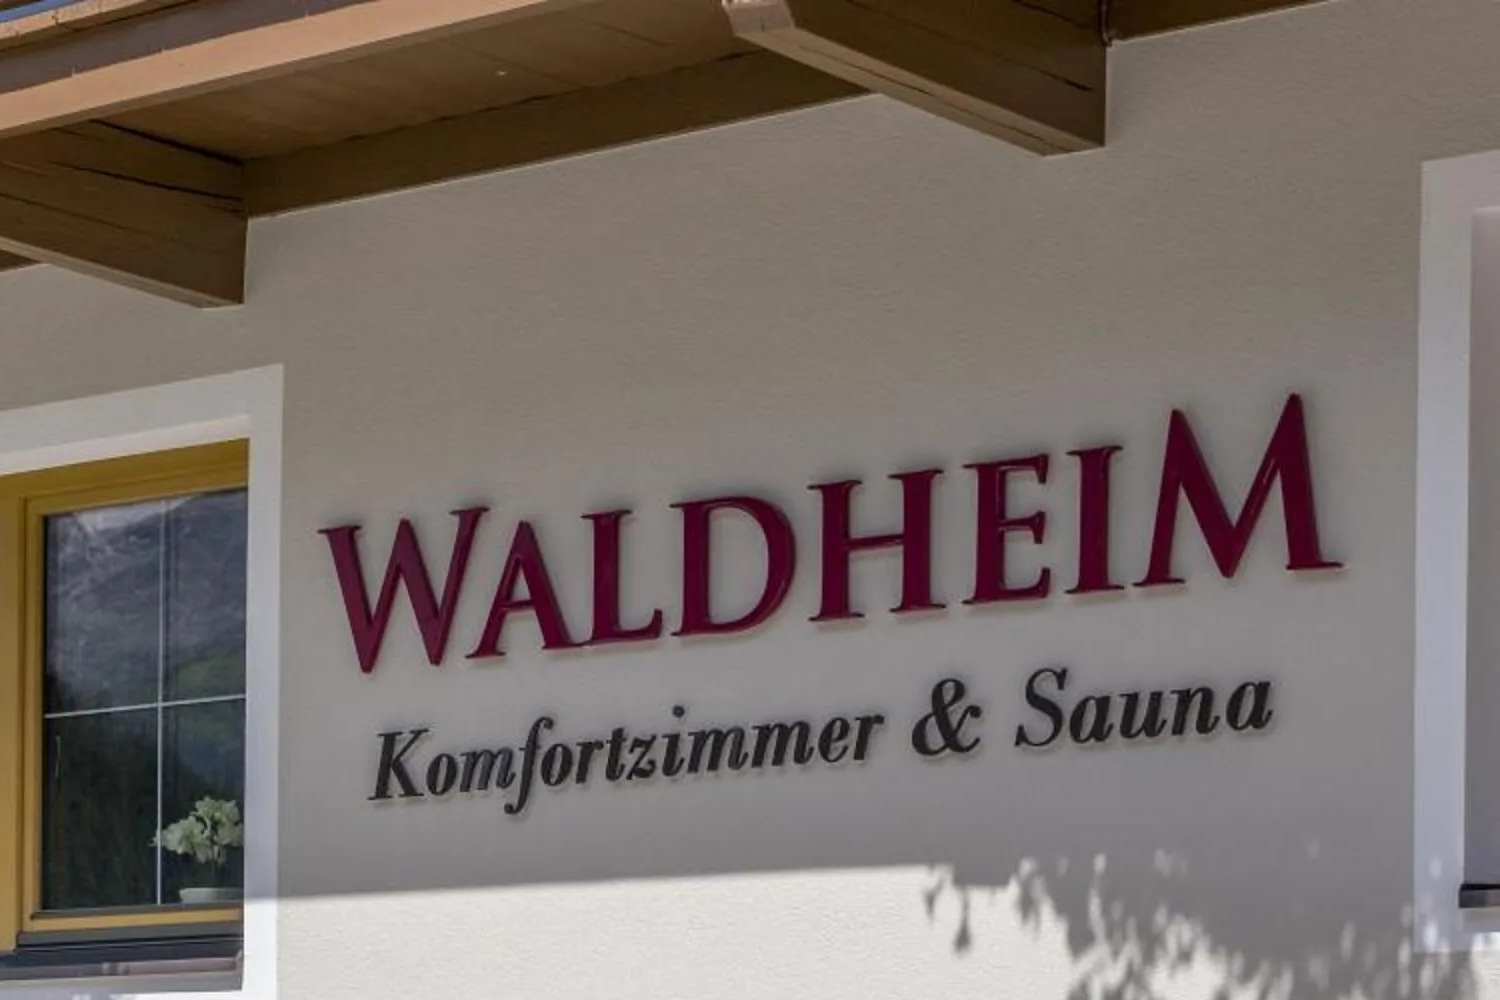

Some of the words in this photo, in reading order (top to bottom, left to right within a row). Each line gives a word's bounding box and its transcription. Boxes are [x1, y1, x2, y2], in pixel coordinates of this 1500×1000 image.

[318, 392, 1344, 673] WALDHEIM
[368, 705, 884, 815] Komfortzimmer
[910, 677, 980, 757] &
[1014, 667, 1275, 748] Sauna
